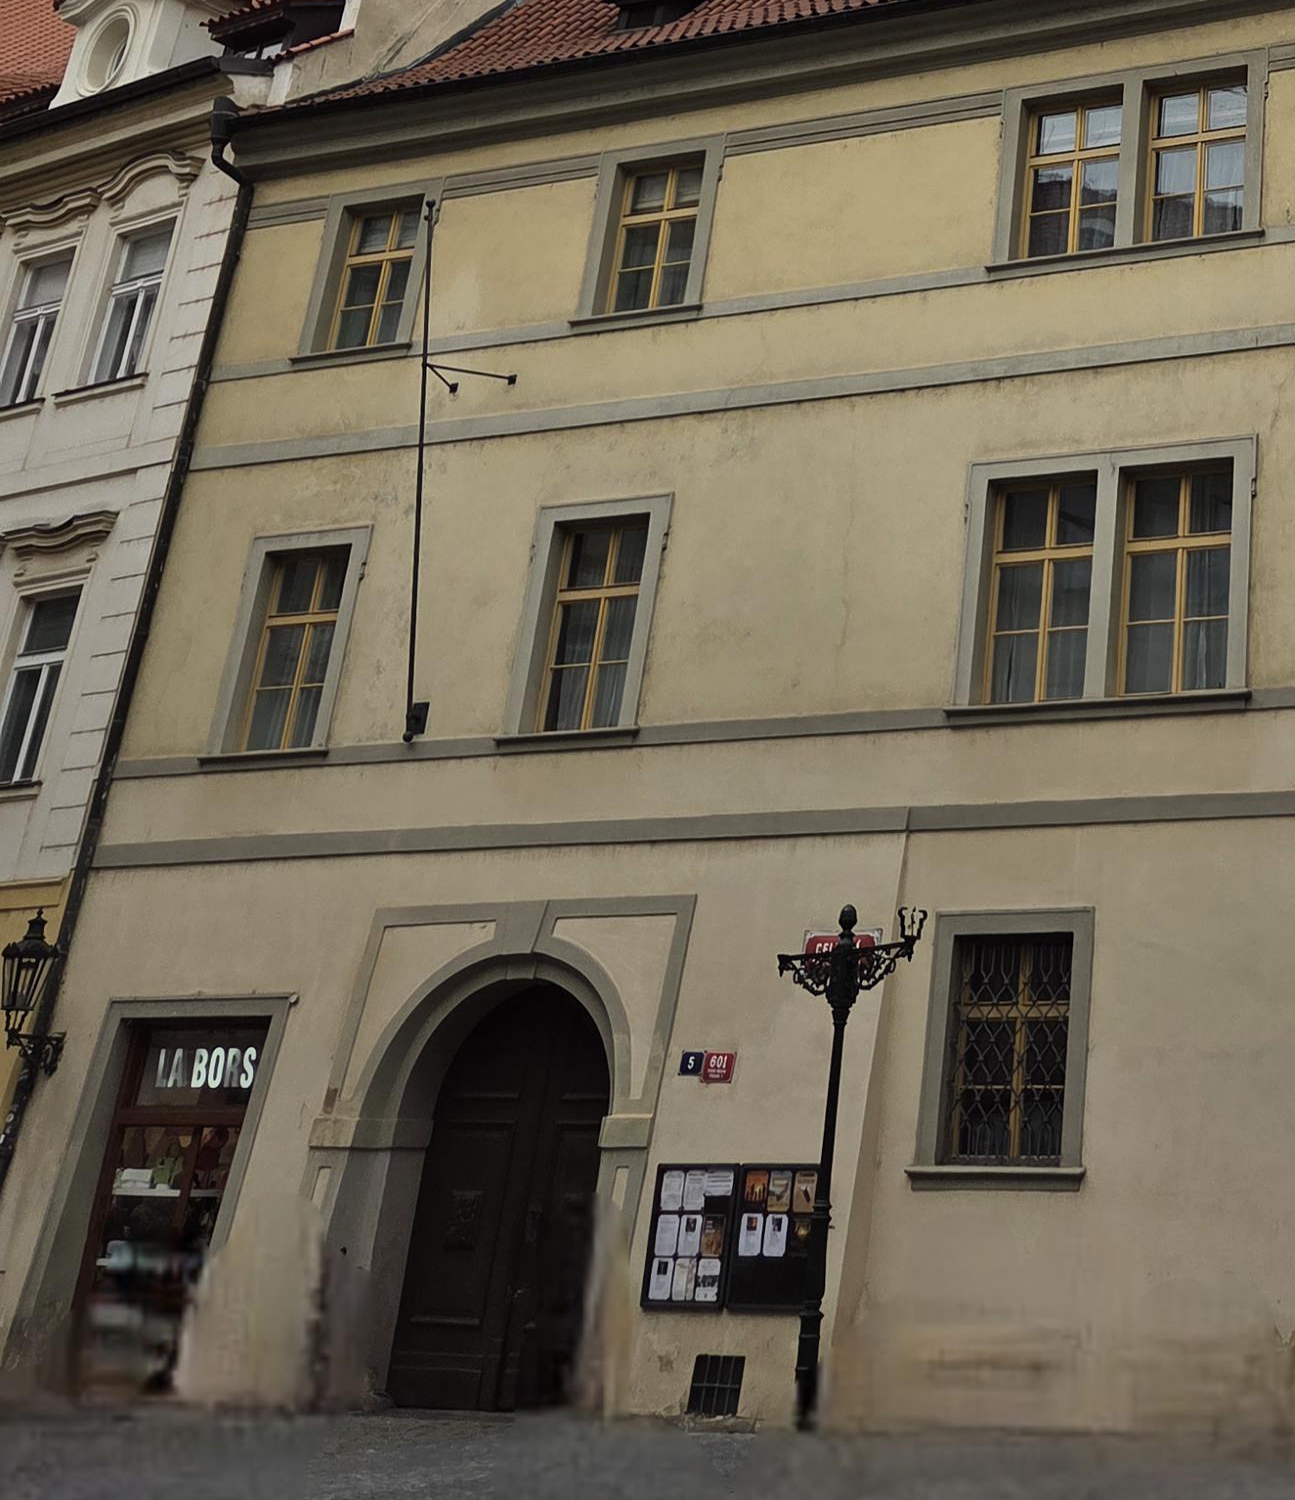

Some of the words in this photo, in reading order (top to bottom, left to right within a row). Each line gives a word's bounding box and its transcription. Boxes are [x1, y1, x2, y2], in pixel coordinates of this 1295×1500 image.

[155, 1048, 186, 1088] LA
[190, 1047, 257, 1089] BORS
[687, 1056, 696, 1070] 5
[709, 1055, 728, 1069] 601
